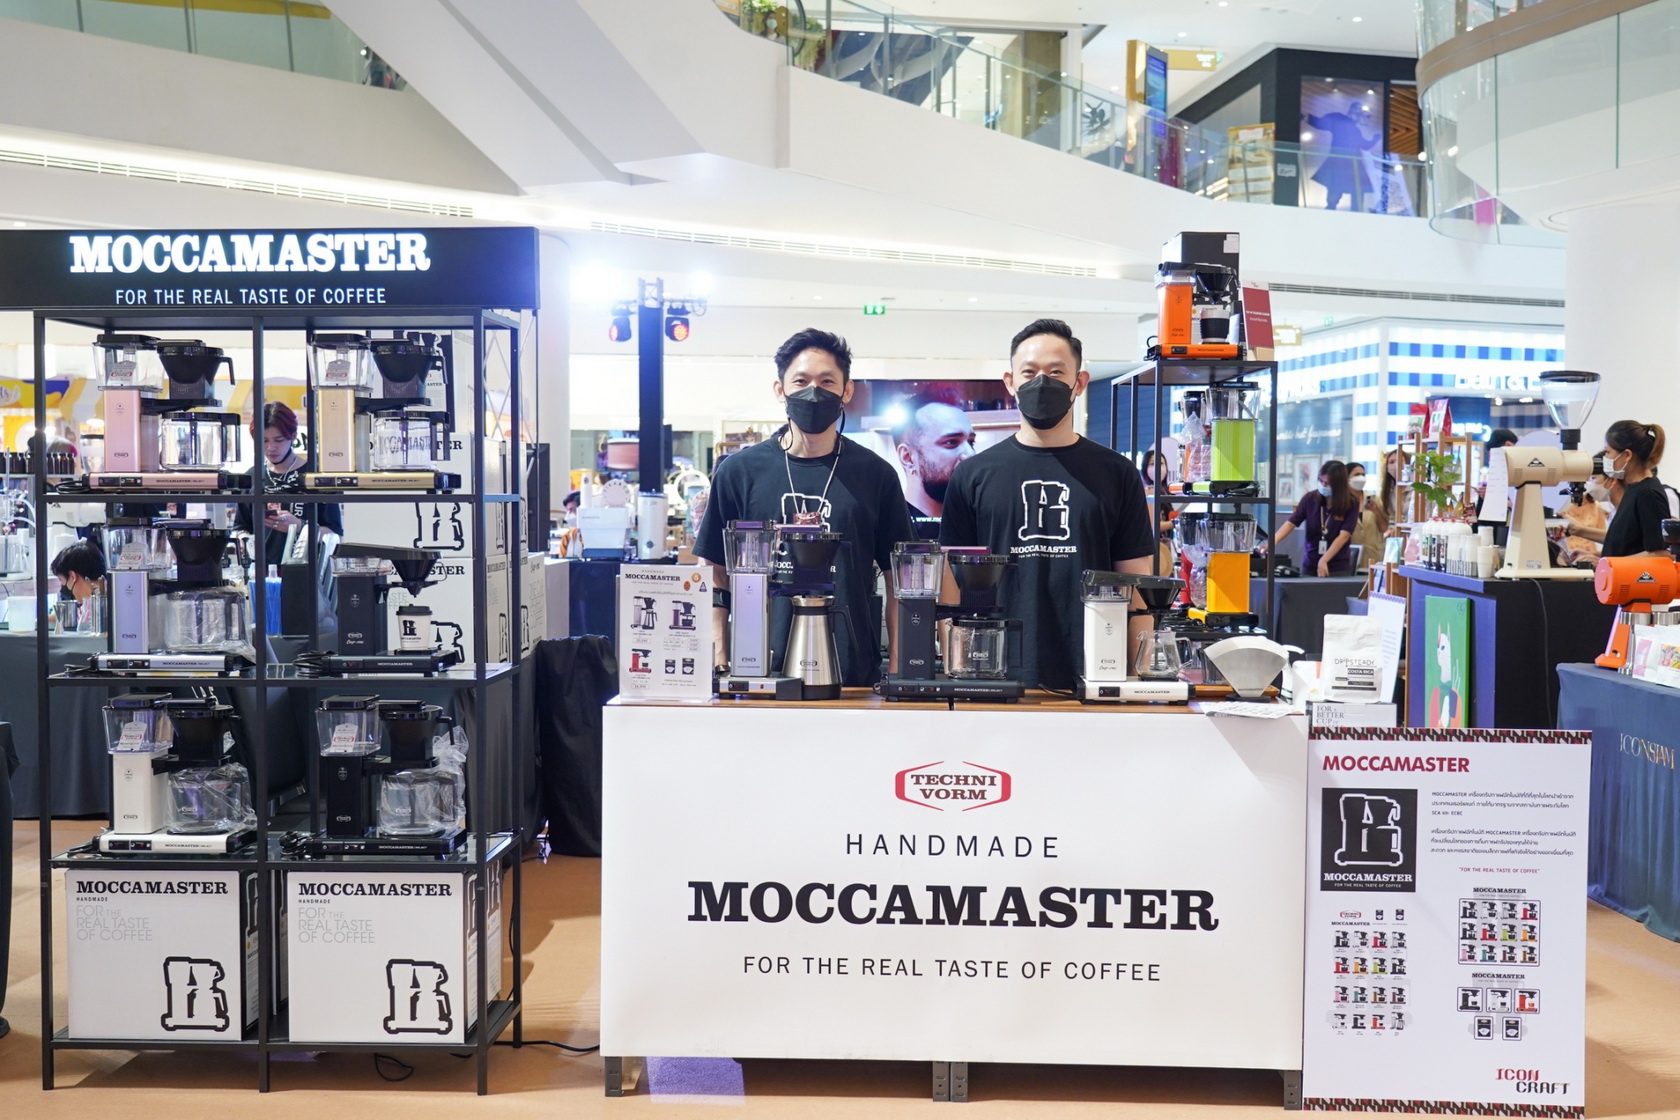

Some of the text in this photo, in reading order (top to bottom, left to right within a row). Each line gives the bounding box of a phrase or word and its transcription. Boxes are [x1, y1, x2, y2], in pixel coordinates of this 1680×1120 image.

[69, 232, 431, 274] MOCCAMASTER
[115, 288, 387, 305] FOR THE REAL TASTE OF COFFEE
[1010, 544, 1077, 554] MOCCAMASTER
[625, 573, 681, 582] MOCCAMASTER
[1620, 733, 1675, 770] ICONSIAM
[1322, 755, 1470, 773] MOCCAMASTER
[911, 774, 997, 786] TECHNI
[919, 788, 987, 800] VORM
[847, 833, 1058, 858] HANDMADE
[1323, 873, 1413, 882] MOCCAMASTER
[76, 881, 228, 894] MOCCAMASTER
[298, 883, 452, 896] MOCCAMASTER
[76, 905, 121, 917] FOR THE
[688, 881, 1219, 932] MOCCAMASTER
[298, 907, 344, 919] FOR THE
[76, 917, 149, 929] REAL TASTE
[298, 919, 372, 931] REAL TASTE
[76, 929, 152, 941] OF COFFEE
[298, 931, 375, 943] OF COFFEE
[743, 956, 1161, 981] FOR THE REAL TASTE OF COFFEE
[1496, 1068, 1540, 1081] ICON
[1515, 1081, 1570, 1095] CRAFT
